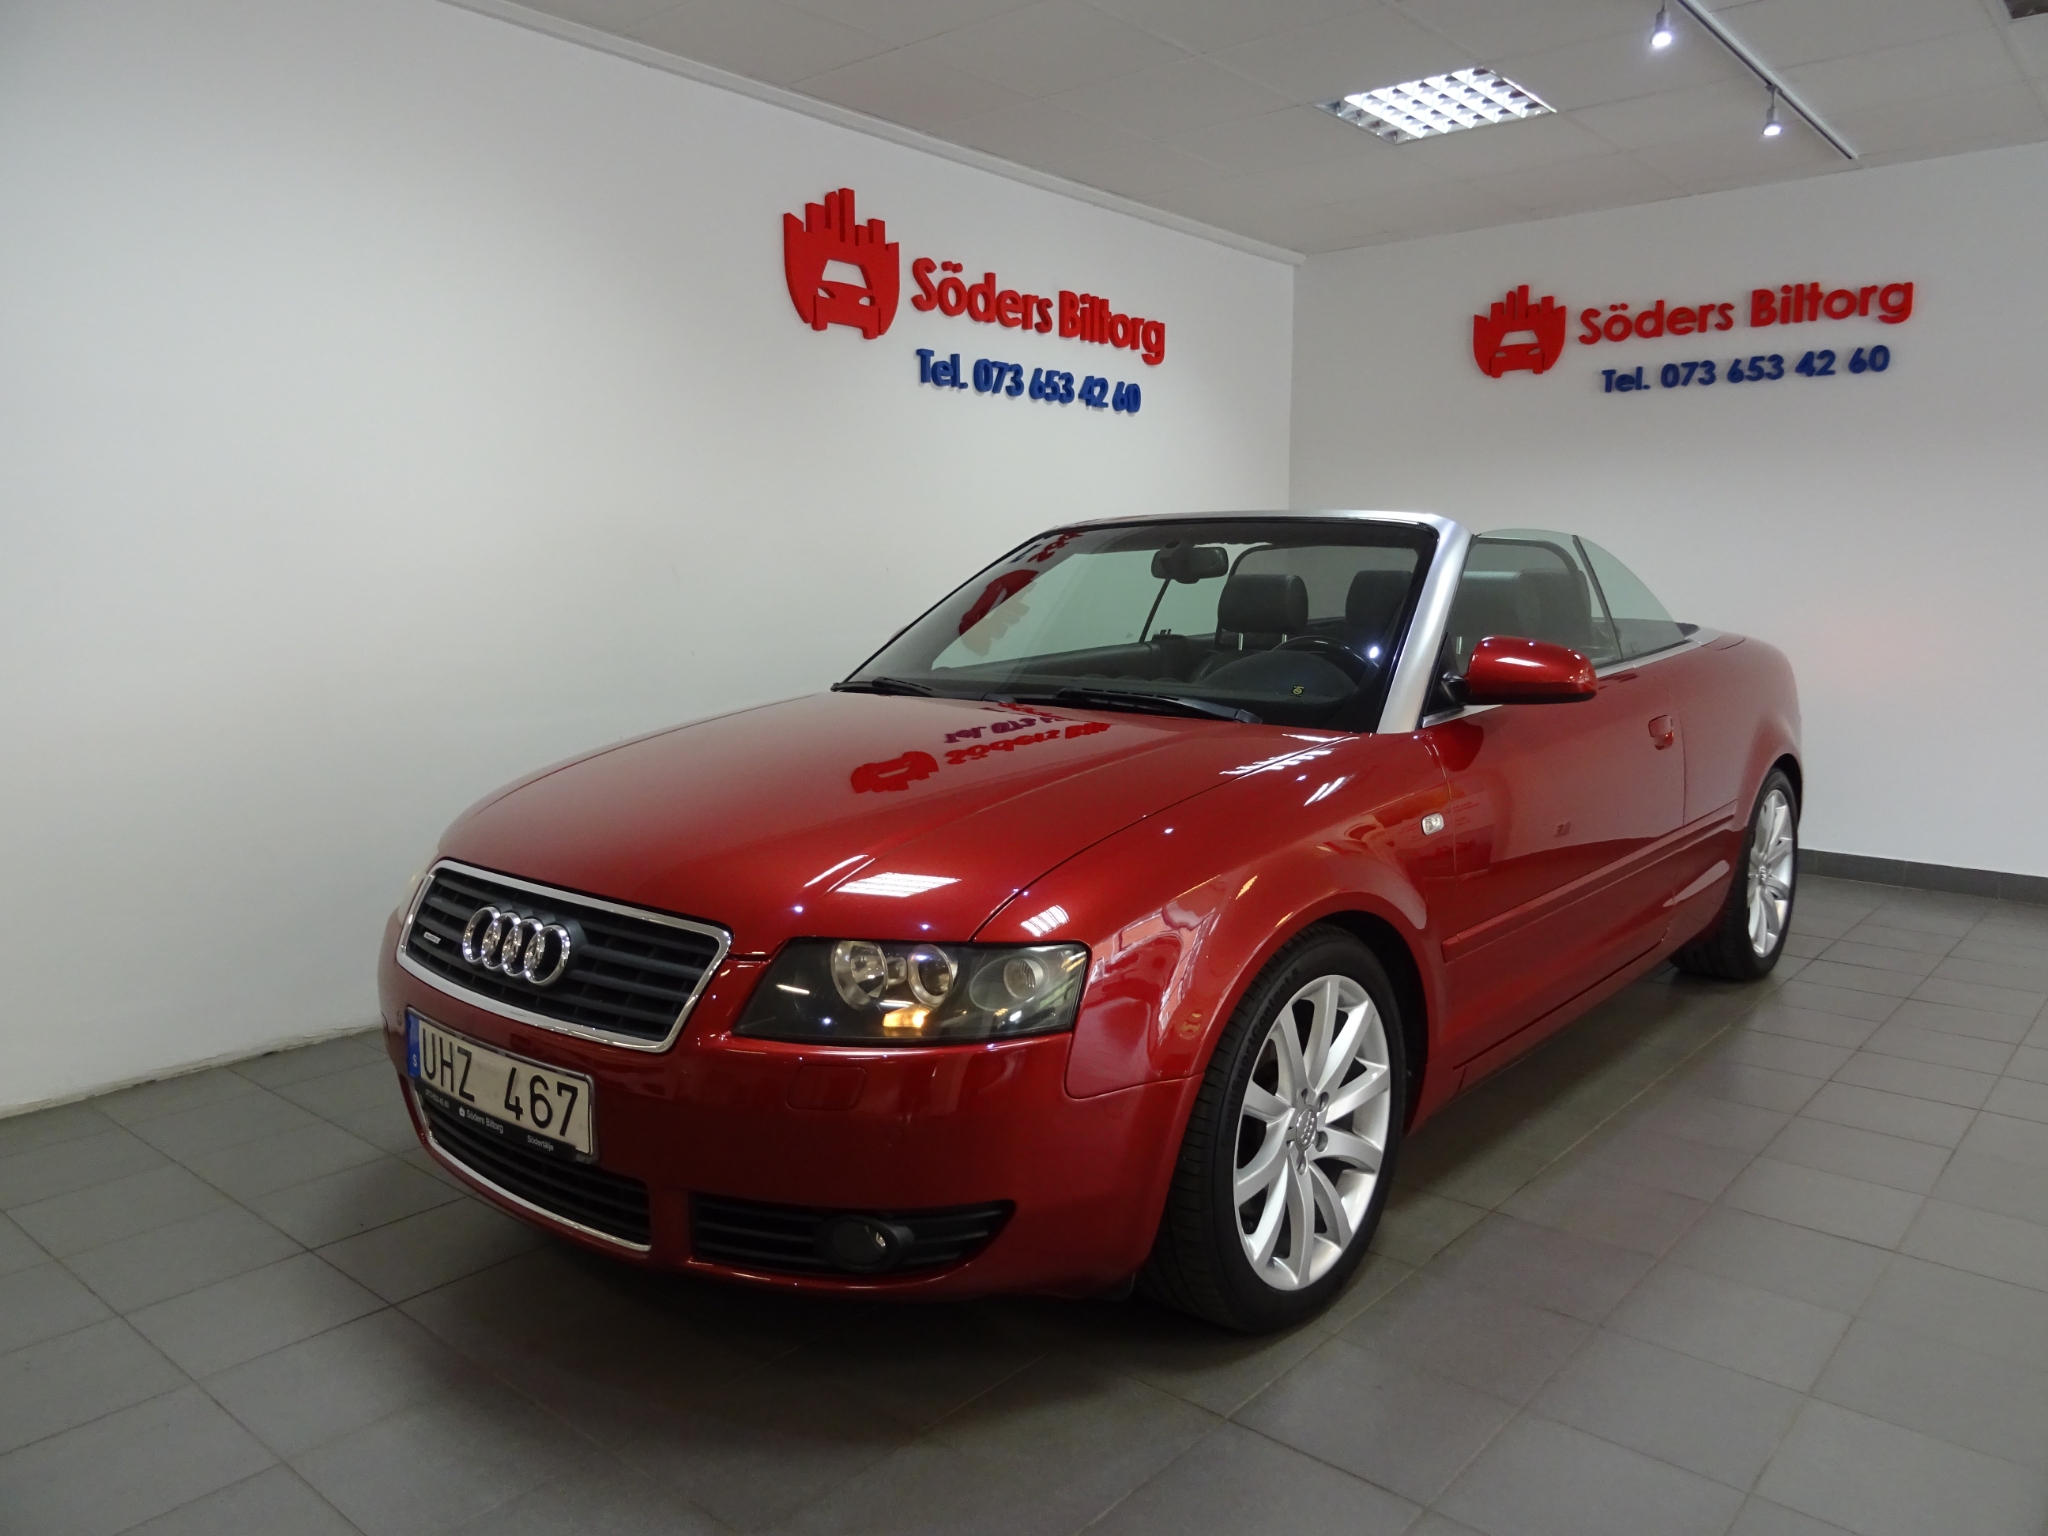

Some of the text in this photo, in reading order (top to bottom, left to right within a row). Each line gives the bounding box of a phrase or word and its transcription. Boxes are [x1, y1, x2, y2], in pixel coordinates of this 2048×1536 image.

[911, 257, 1165, 366] Söders Biltorg
[1577, 281, 1915, 345] Söders Biltorg
[916, 348, 1142, 414] Tel. 073 653 42 60
[1601, 345, 1891, 393] Tel. 073 653 42 60
[412, 1053, 418, 1068] S
[422, 1028, 579, 1137] UHZ 467
[466, 1108, 504, 1134] Söders Biltorg
